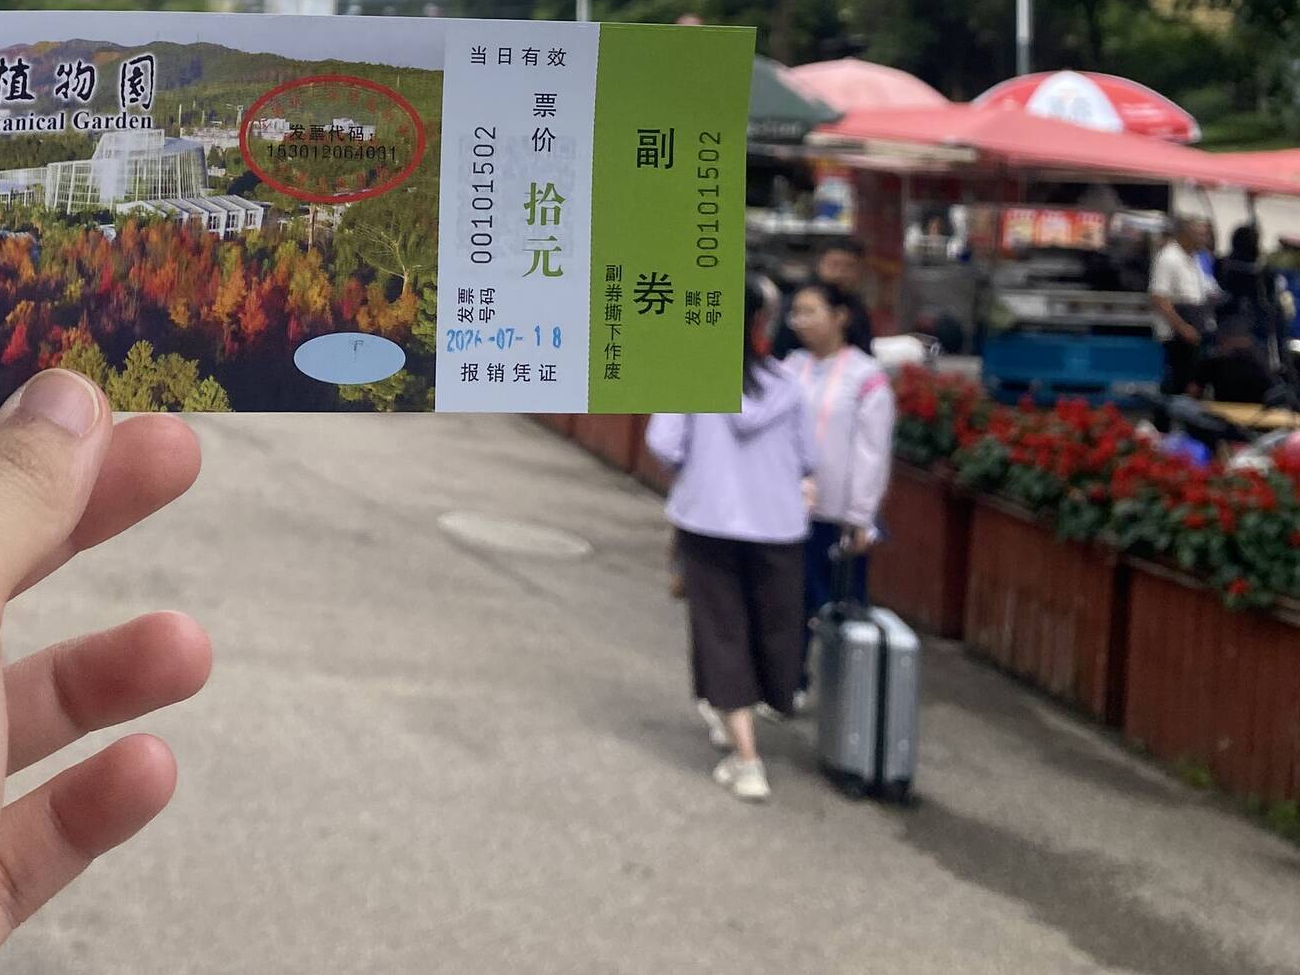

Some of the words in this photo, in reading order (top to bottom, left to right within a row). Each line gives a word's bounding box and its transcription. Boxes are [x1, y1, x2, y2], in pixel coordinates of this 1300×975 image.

[470, 45, 567, 67] 当日有效
[73, 111, 153, 131] Garden
[532, 93, 557, 153] 票价
[471, 126, 497, 264] 00101502
[523, 182, 566, 278] 拾元
[696, 131, 722, 268] 00101502
[604, 264, 622, 380] 副券撕下作废
[460, 363, 557, 382] 报销凭证
